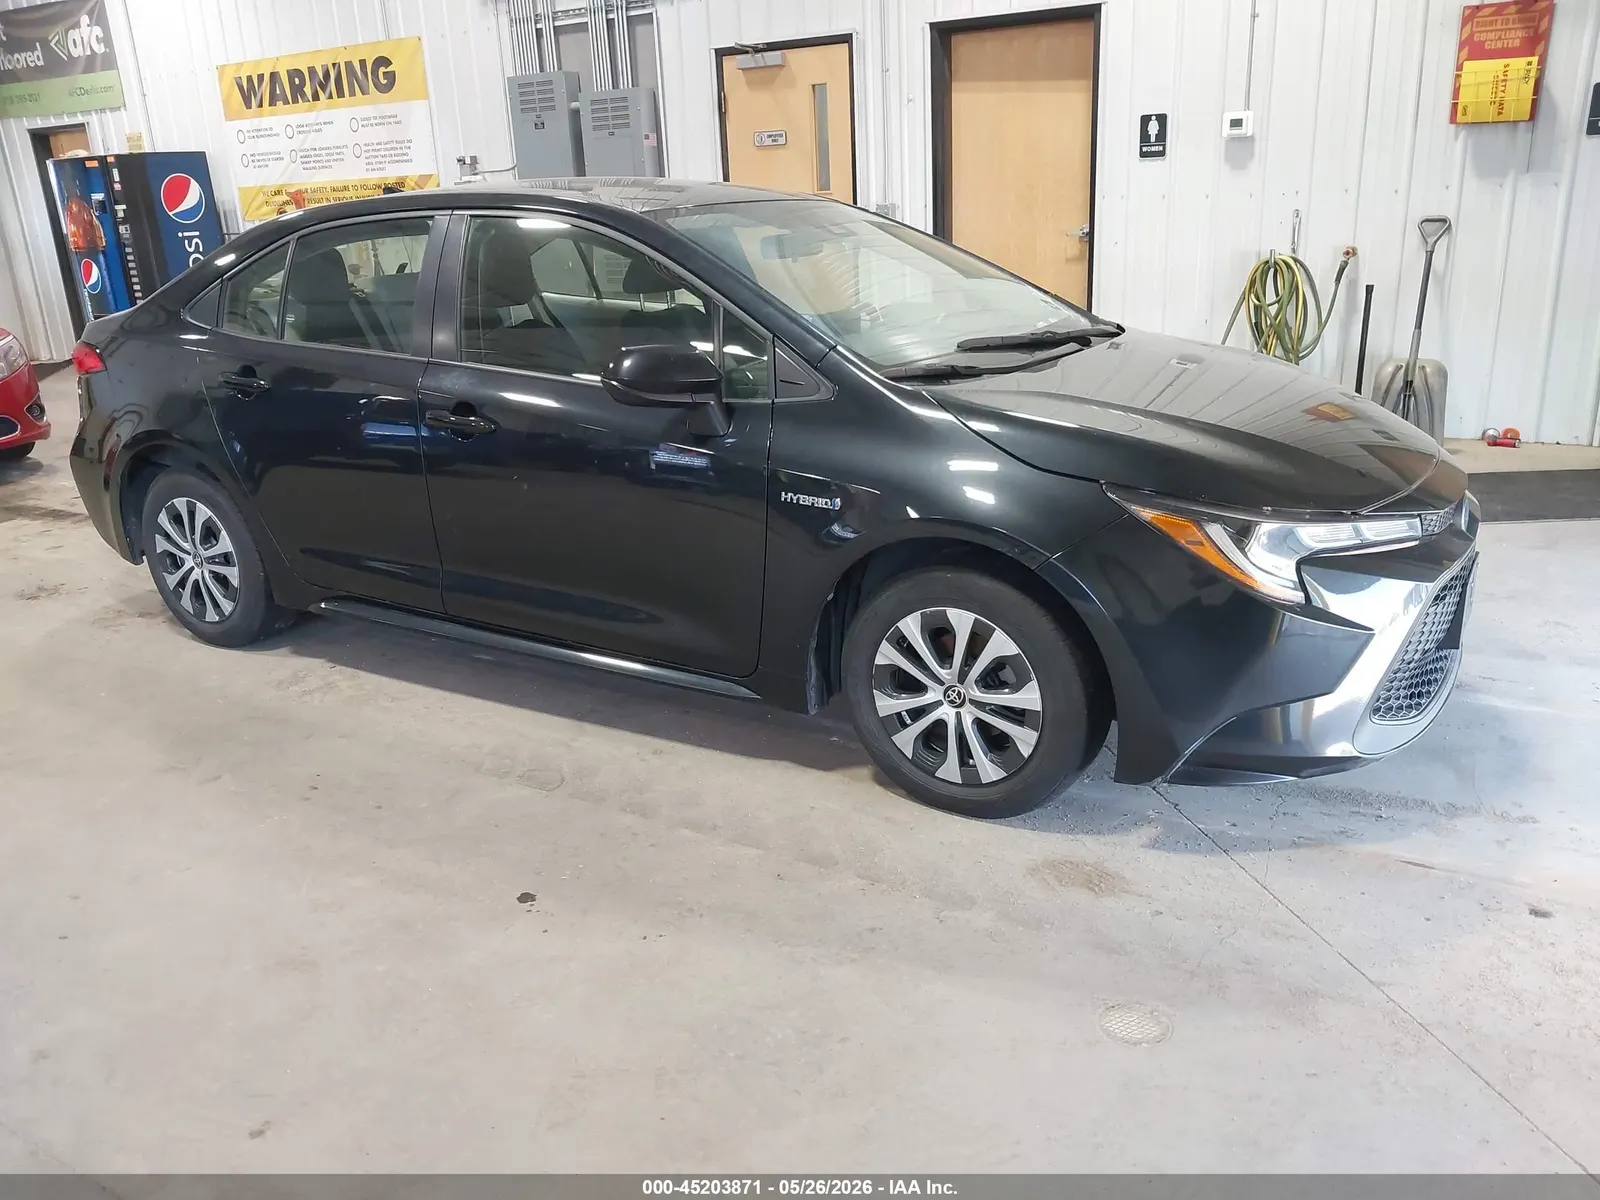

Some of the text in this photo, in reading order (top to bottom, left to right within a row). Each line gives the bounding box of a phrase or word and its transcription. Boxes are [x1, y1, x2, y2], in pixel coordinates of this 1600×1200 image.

[1485, 39, 1520, 49] CENTER
[234, 56, 396, 110] WARNING
[1497, 63, 1510, 116] SAFETY DATA
[781, 492, 831, 508] HYBRID
